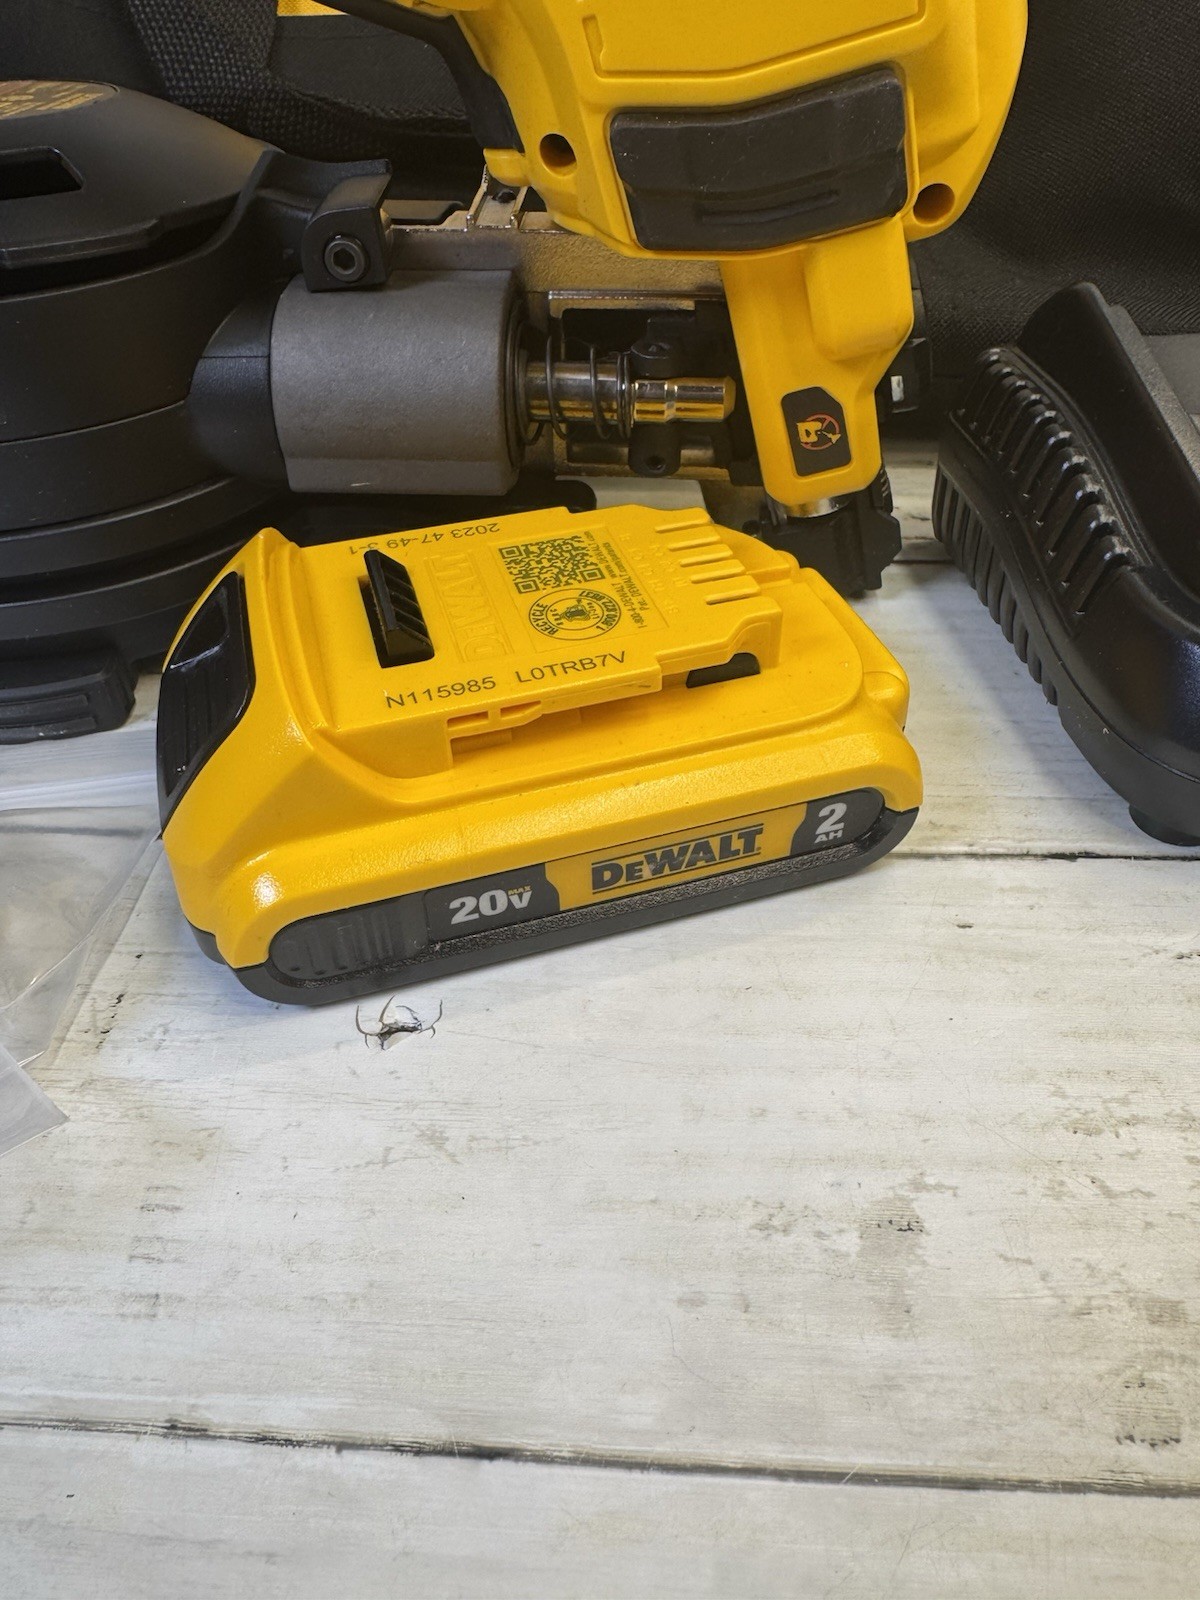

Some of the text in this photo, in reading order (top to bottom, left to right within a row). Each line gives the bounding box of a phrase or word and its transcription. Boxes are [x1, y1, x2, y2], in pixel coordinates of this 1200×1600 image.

[387, 532, 444, 549] 47-49
[450, 522, 501, 539] 2023
[531, 602, 559, 636] RECYCLE
[386, 675, 497, 709] N115985
[815, 802, 847, 835] 2
[814, 829, 842, 843] AH
[591, 827, 764, 891] DEWALT
[507, 885, 531, 896] MAX
